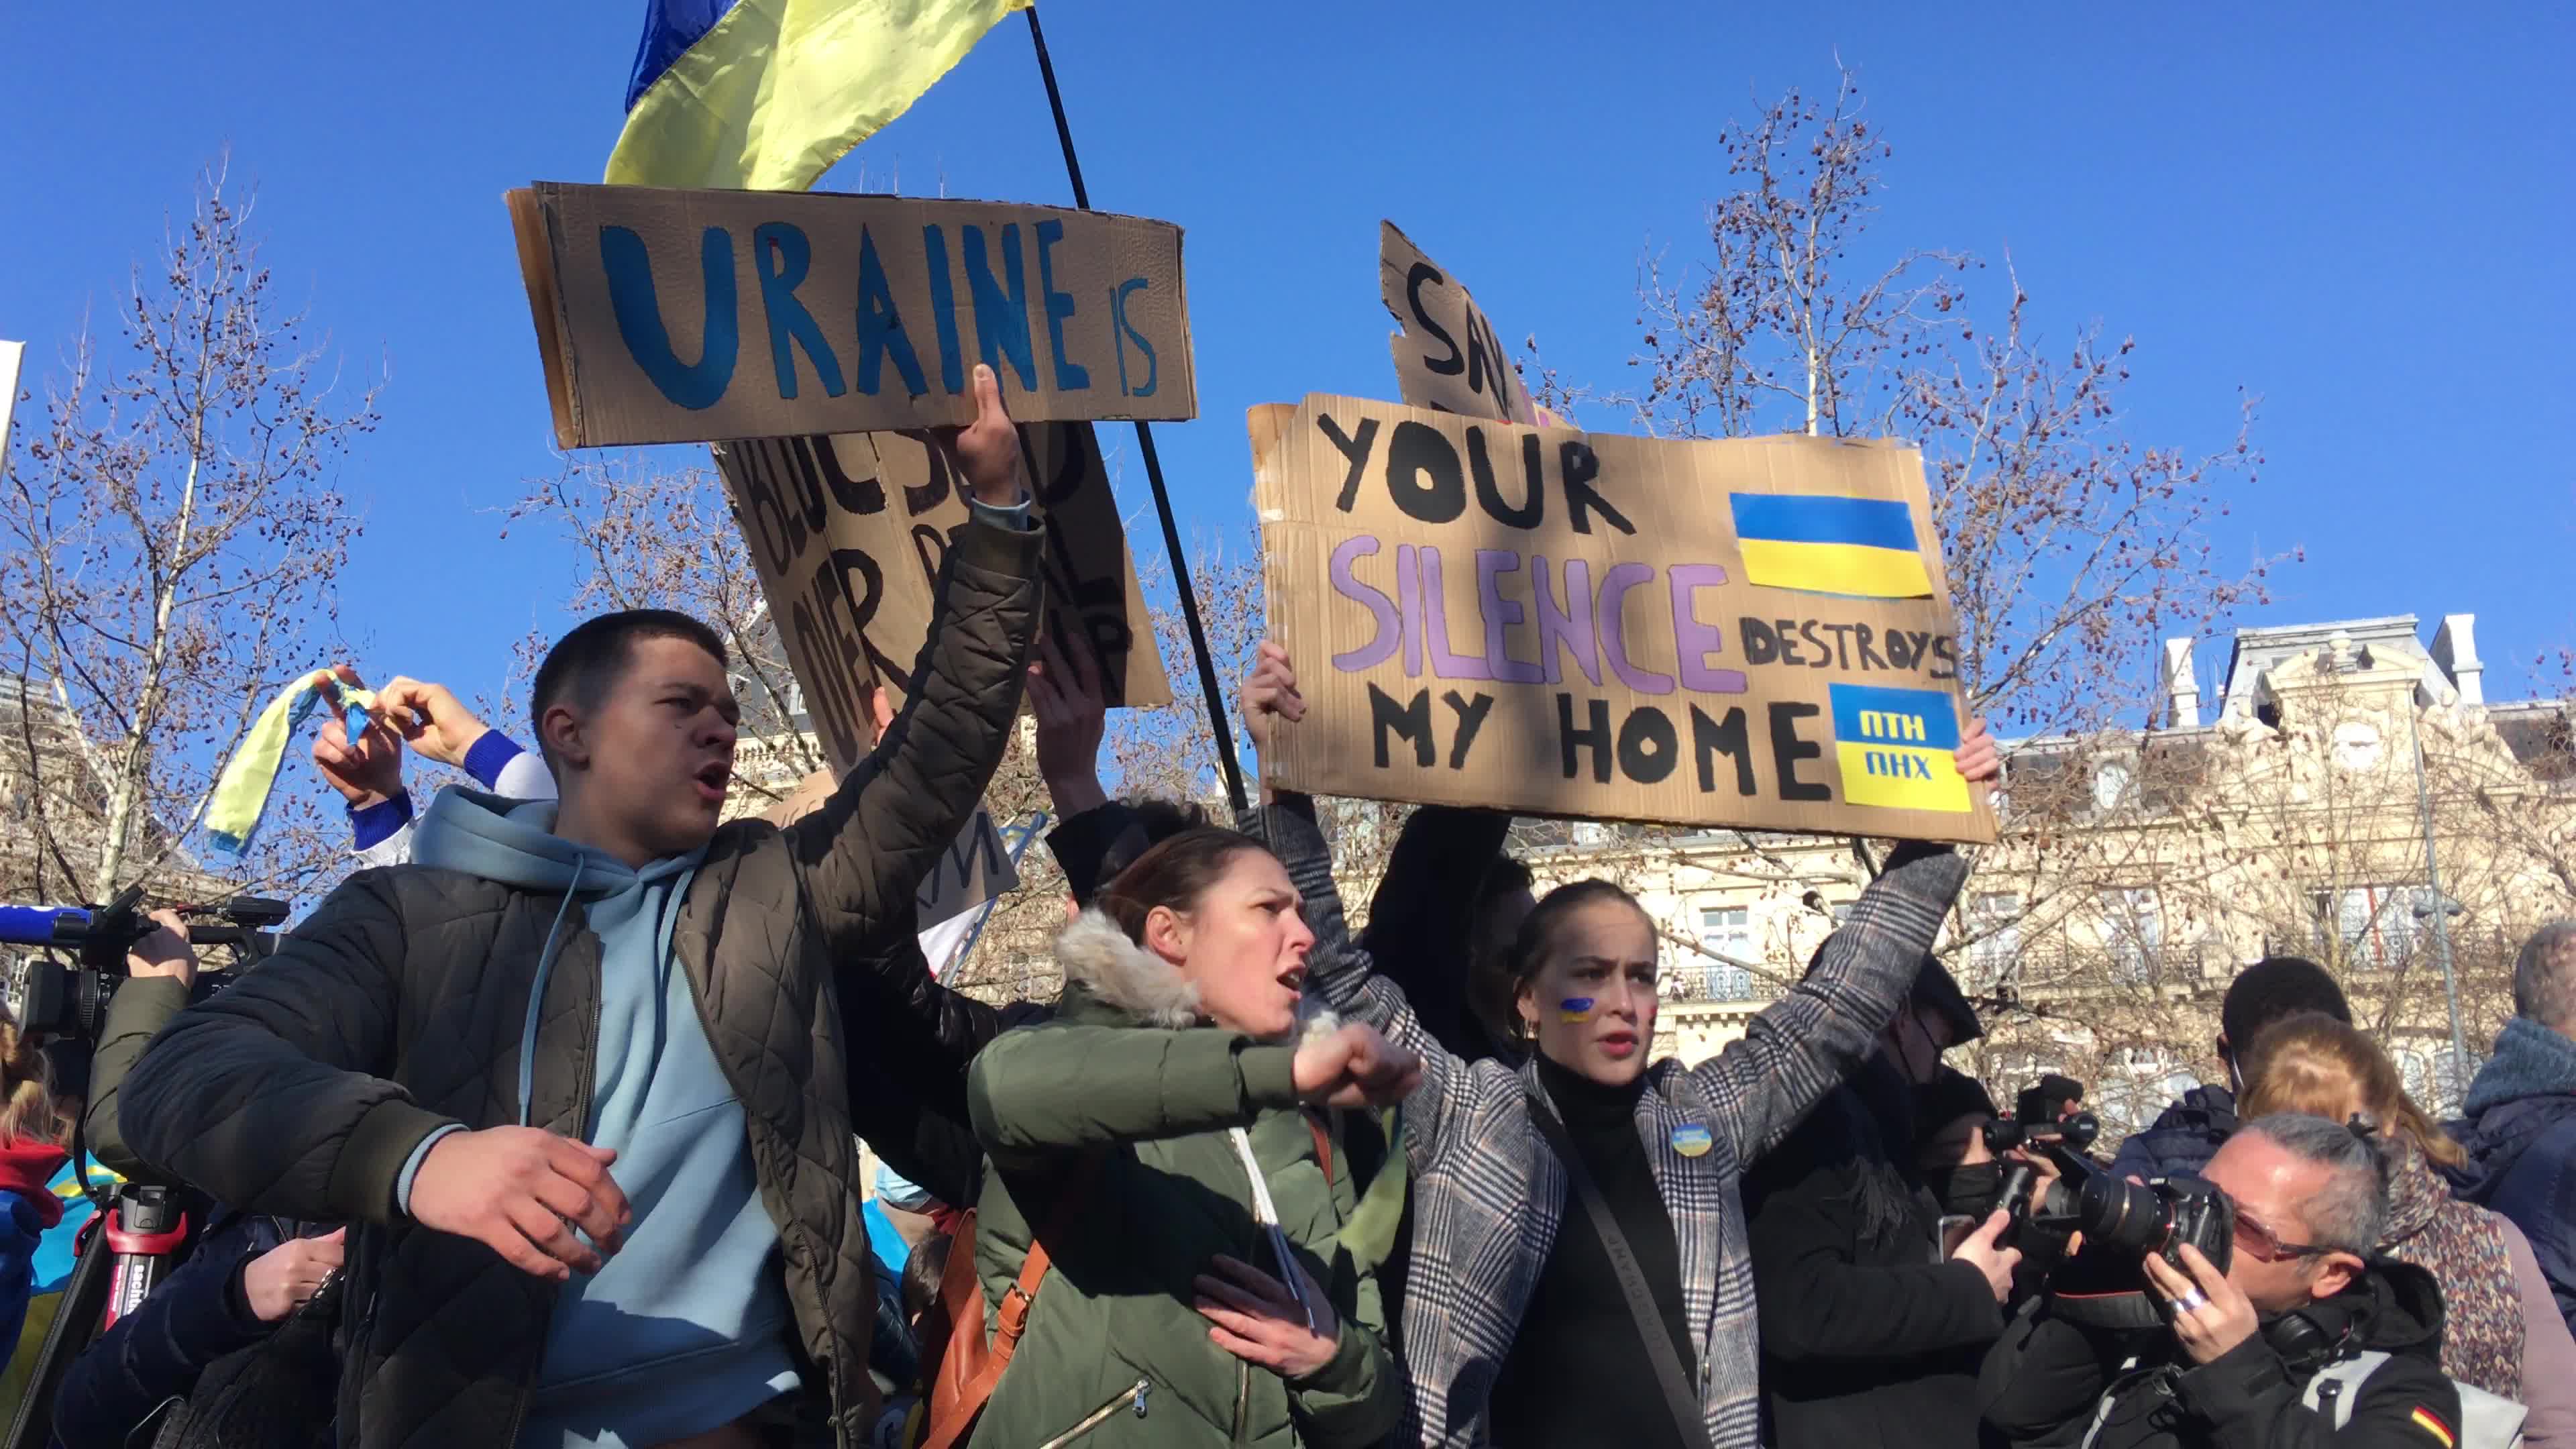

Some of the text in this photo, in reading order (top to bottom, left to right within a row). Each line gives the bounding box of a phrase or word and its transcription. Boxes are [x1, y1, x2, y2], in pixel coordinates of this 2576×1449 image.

[600, 217, 1157, 411] URAINE IS
[1317, 413, 1637, 535] YOUR
[1329, 535, 1958, 695] SILENCE DESTROYS
[1368, 681, 1832, 801] MY HOME
[1859, 710, 1926, 742] ПТН
[1866, 750, 1933, 781] ПНХ
